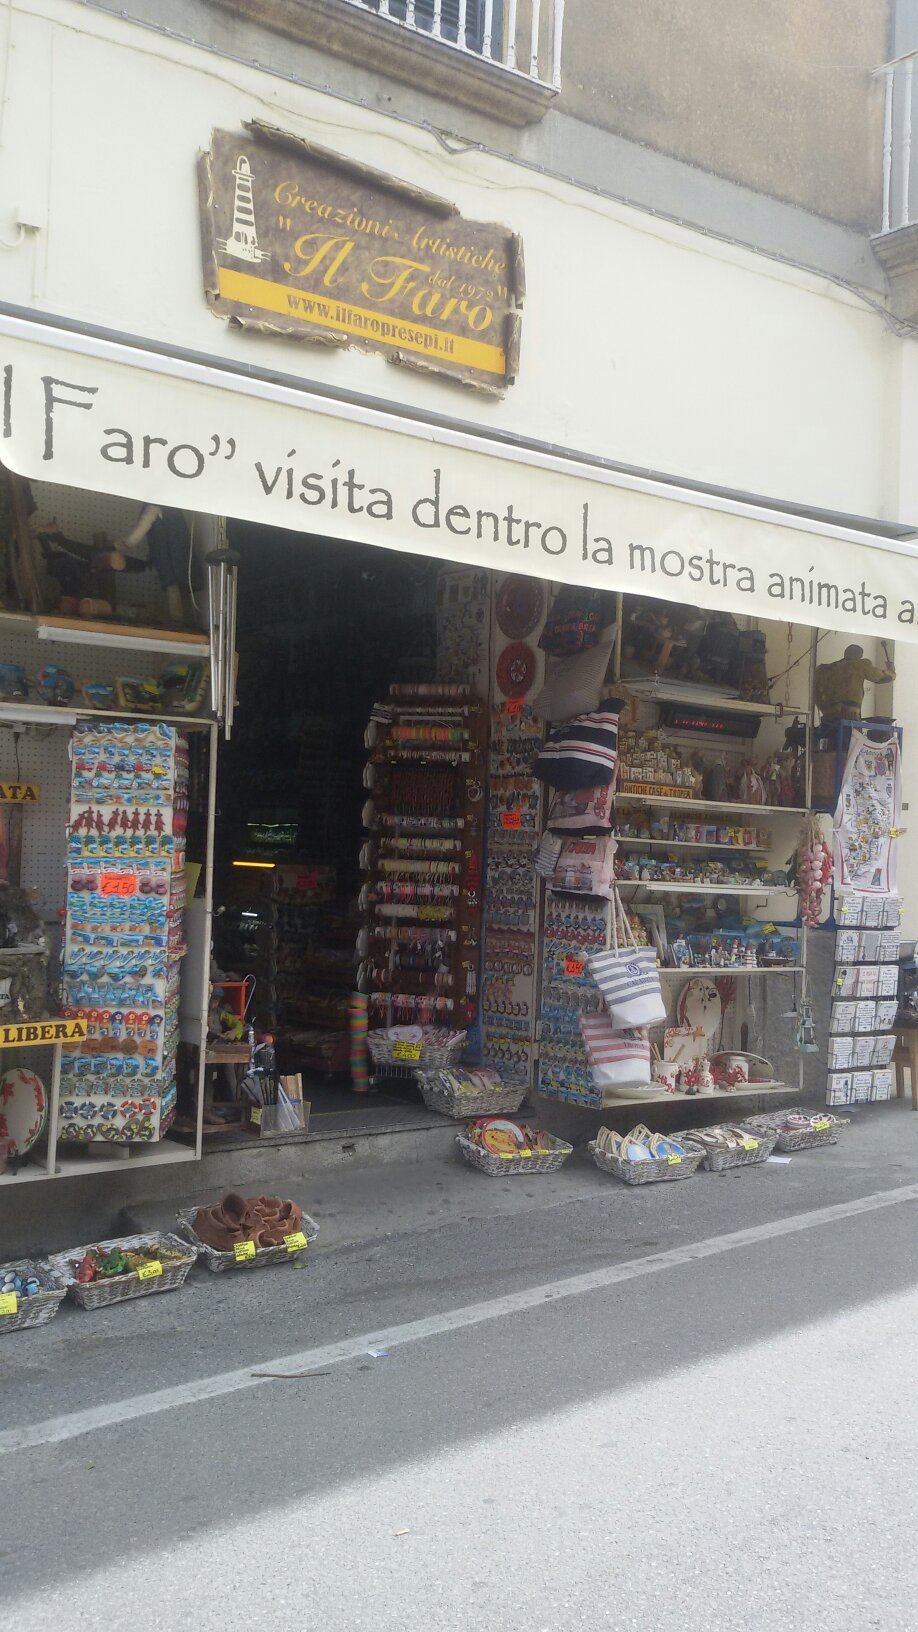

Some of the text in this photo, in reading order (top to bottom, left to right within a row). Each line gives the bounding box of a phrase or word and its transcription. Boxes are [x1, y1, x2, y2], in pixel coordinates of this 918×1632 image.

[274, 181, 506, 275] Creazioni Artistiche
[428, 270, 455, 289] dal
[287, 294, 455, 354] www.ilfaropresepi.it
[254, 448, 394, 521] visita
[411, 468, 567, 556] dentro
[582, 502, 614, 566] la
[628, 541, 756, 593] mostra
[767, 565, 888, 620] animata
[3, 1022, 86, 1043] LIBERA
